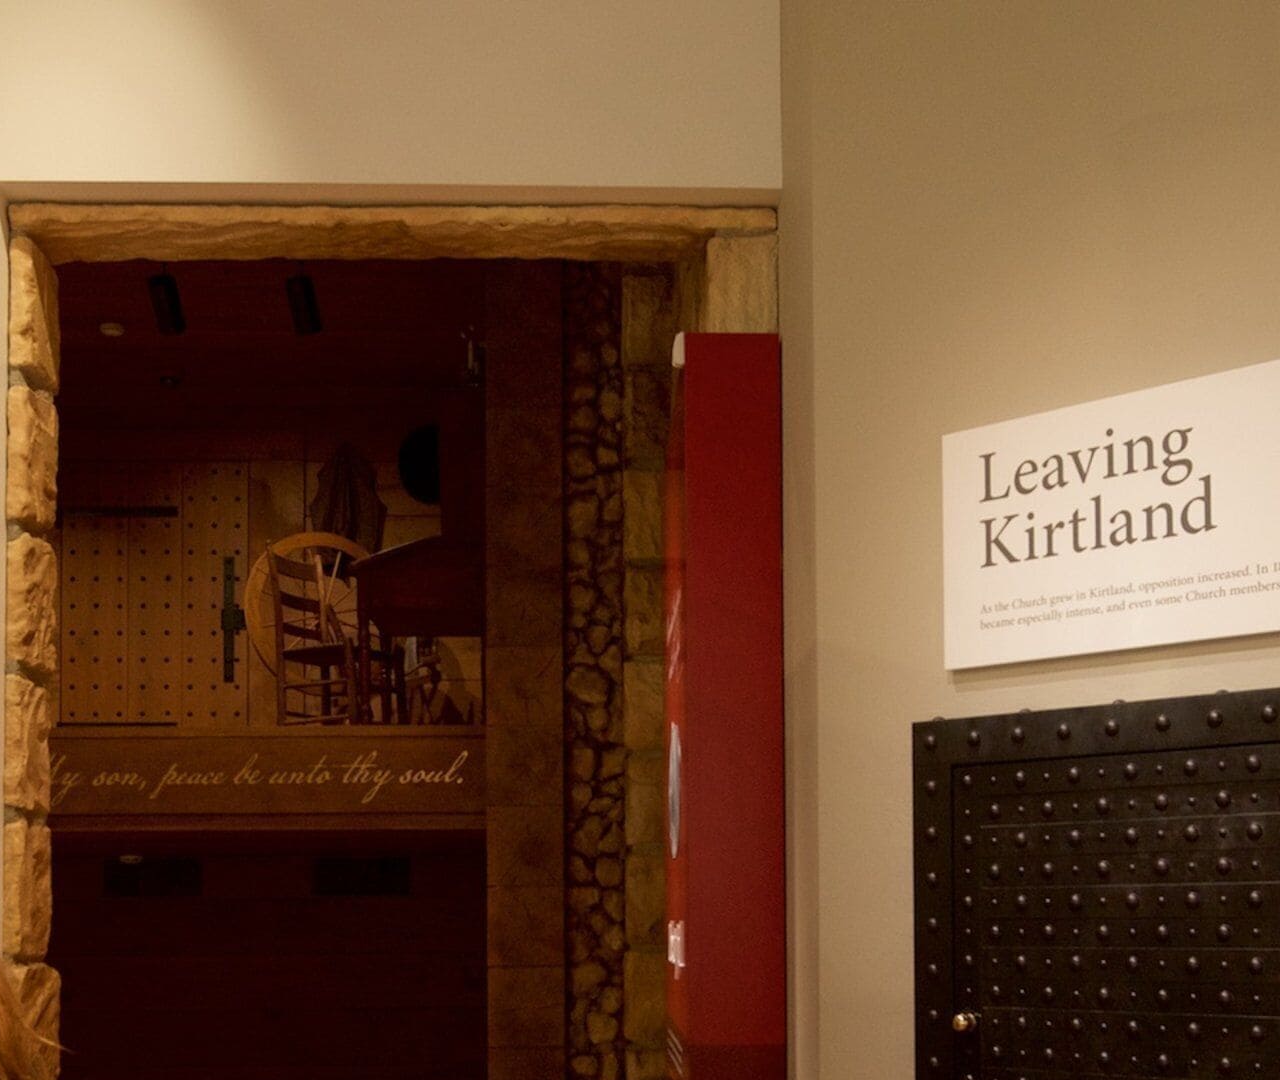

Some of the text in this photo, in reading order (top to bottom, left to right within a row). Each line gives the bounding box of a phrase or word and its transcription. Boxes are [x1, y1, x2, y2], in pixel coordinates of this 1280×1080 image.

[979, 427, 1194, 503] Leaving
[980, 475, 1218, 568] Kirtland
[980, 604, 992, 615] As
[995, 600, 1010, 611] the
[1012, 596, 1048, 610] Church
[1049, 595, 1073, 608] grew
[1076, 590, 1087, 600] in
[1089, 582, 1135, 599] Kirtland,
[1138, 573, 1195, 594] opposition
[1197, 566, 1252, 584] increased.
[1256, 563, 1269, 575] In
[980, 617, 1019, 631] became
[1017, 609, 1062, 627] especially
[1065, 604, 1104, 619] intense,
[1106, 600, 1126, 613] and
[1128, 598, 1152, 611] even
[1154, 593, 1183, 608] some
[1185, 586, 1227, 602] Church
[92, 771, 147, 791] son,
[149, 763, 226, 799] peace
[233, 753, 263, 785] be
[269, 755, 332, 785] unto
[334, 750, 393, 804] thy
[399, 750, 468, 785] soul.
